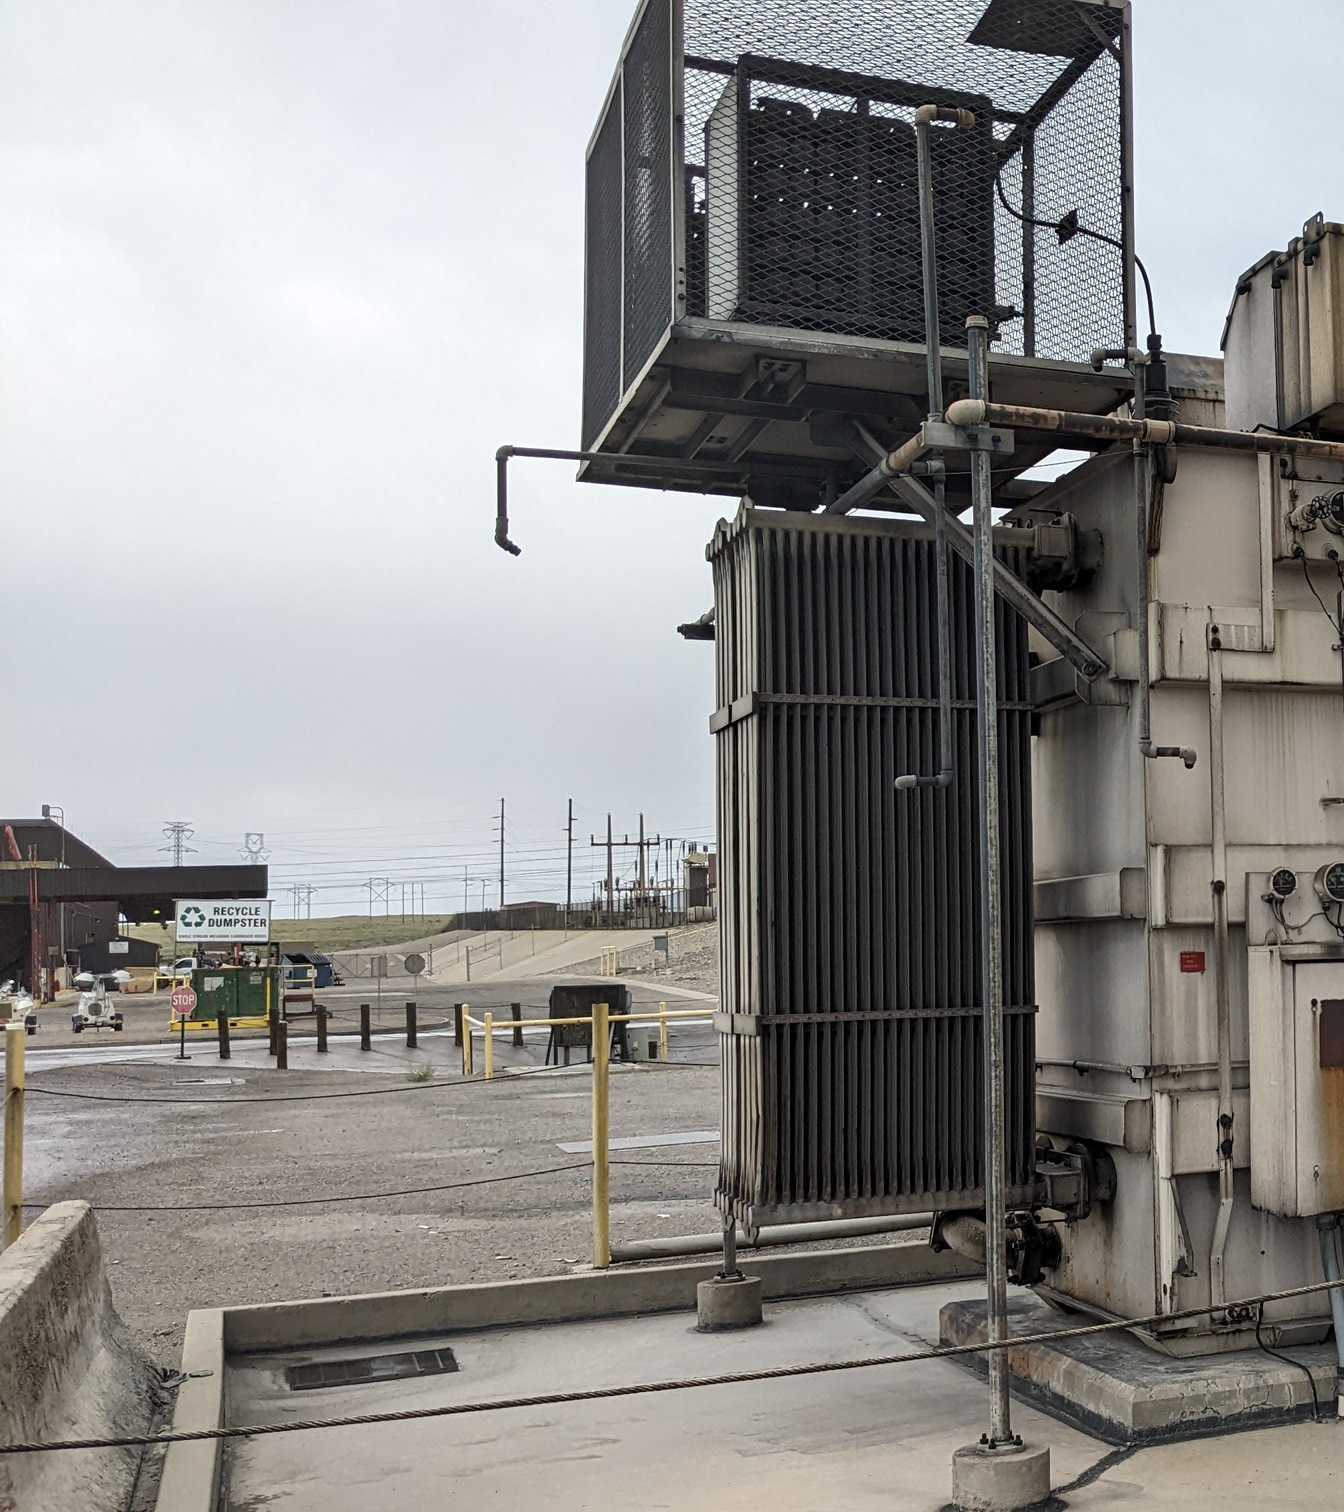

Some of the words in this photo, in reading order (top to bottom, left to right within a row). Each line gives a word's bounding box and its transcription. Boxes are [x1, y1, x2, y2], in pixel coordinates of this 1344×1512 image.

[213, 906, 261, 915] RECYCLE
[208, 918, 267, 927] DUMPSTER
[172, 994, 195, 1005] STOP
